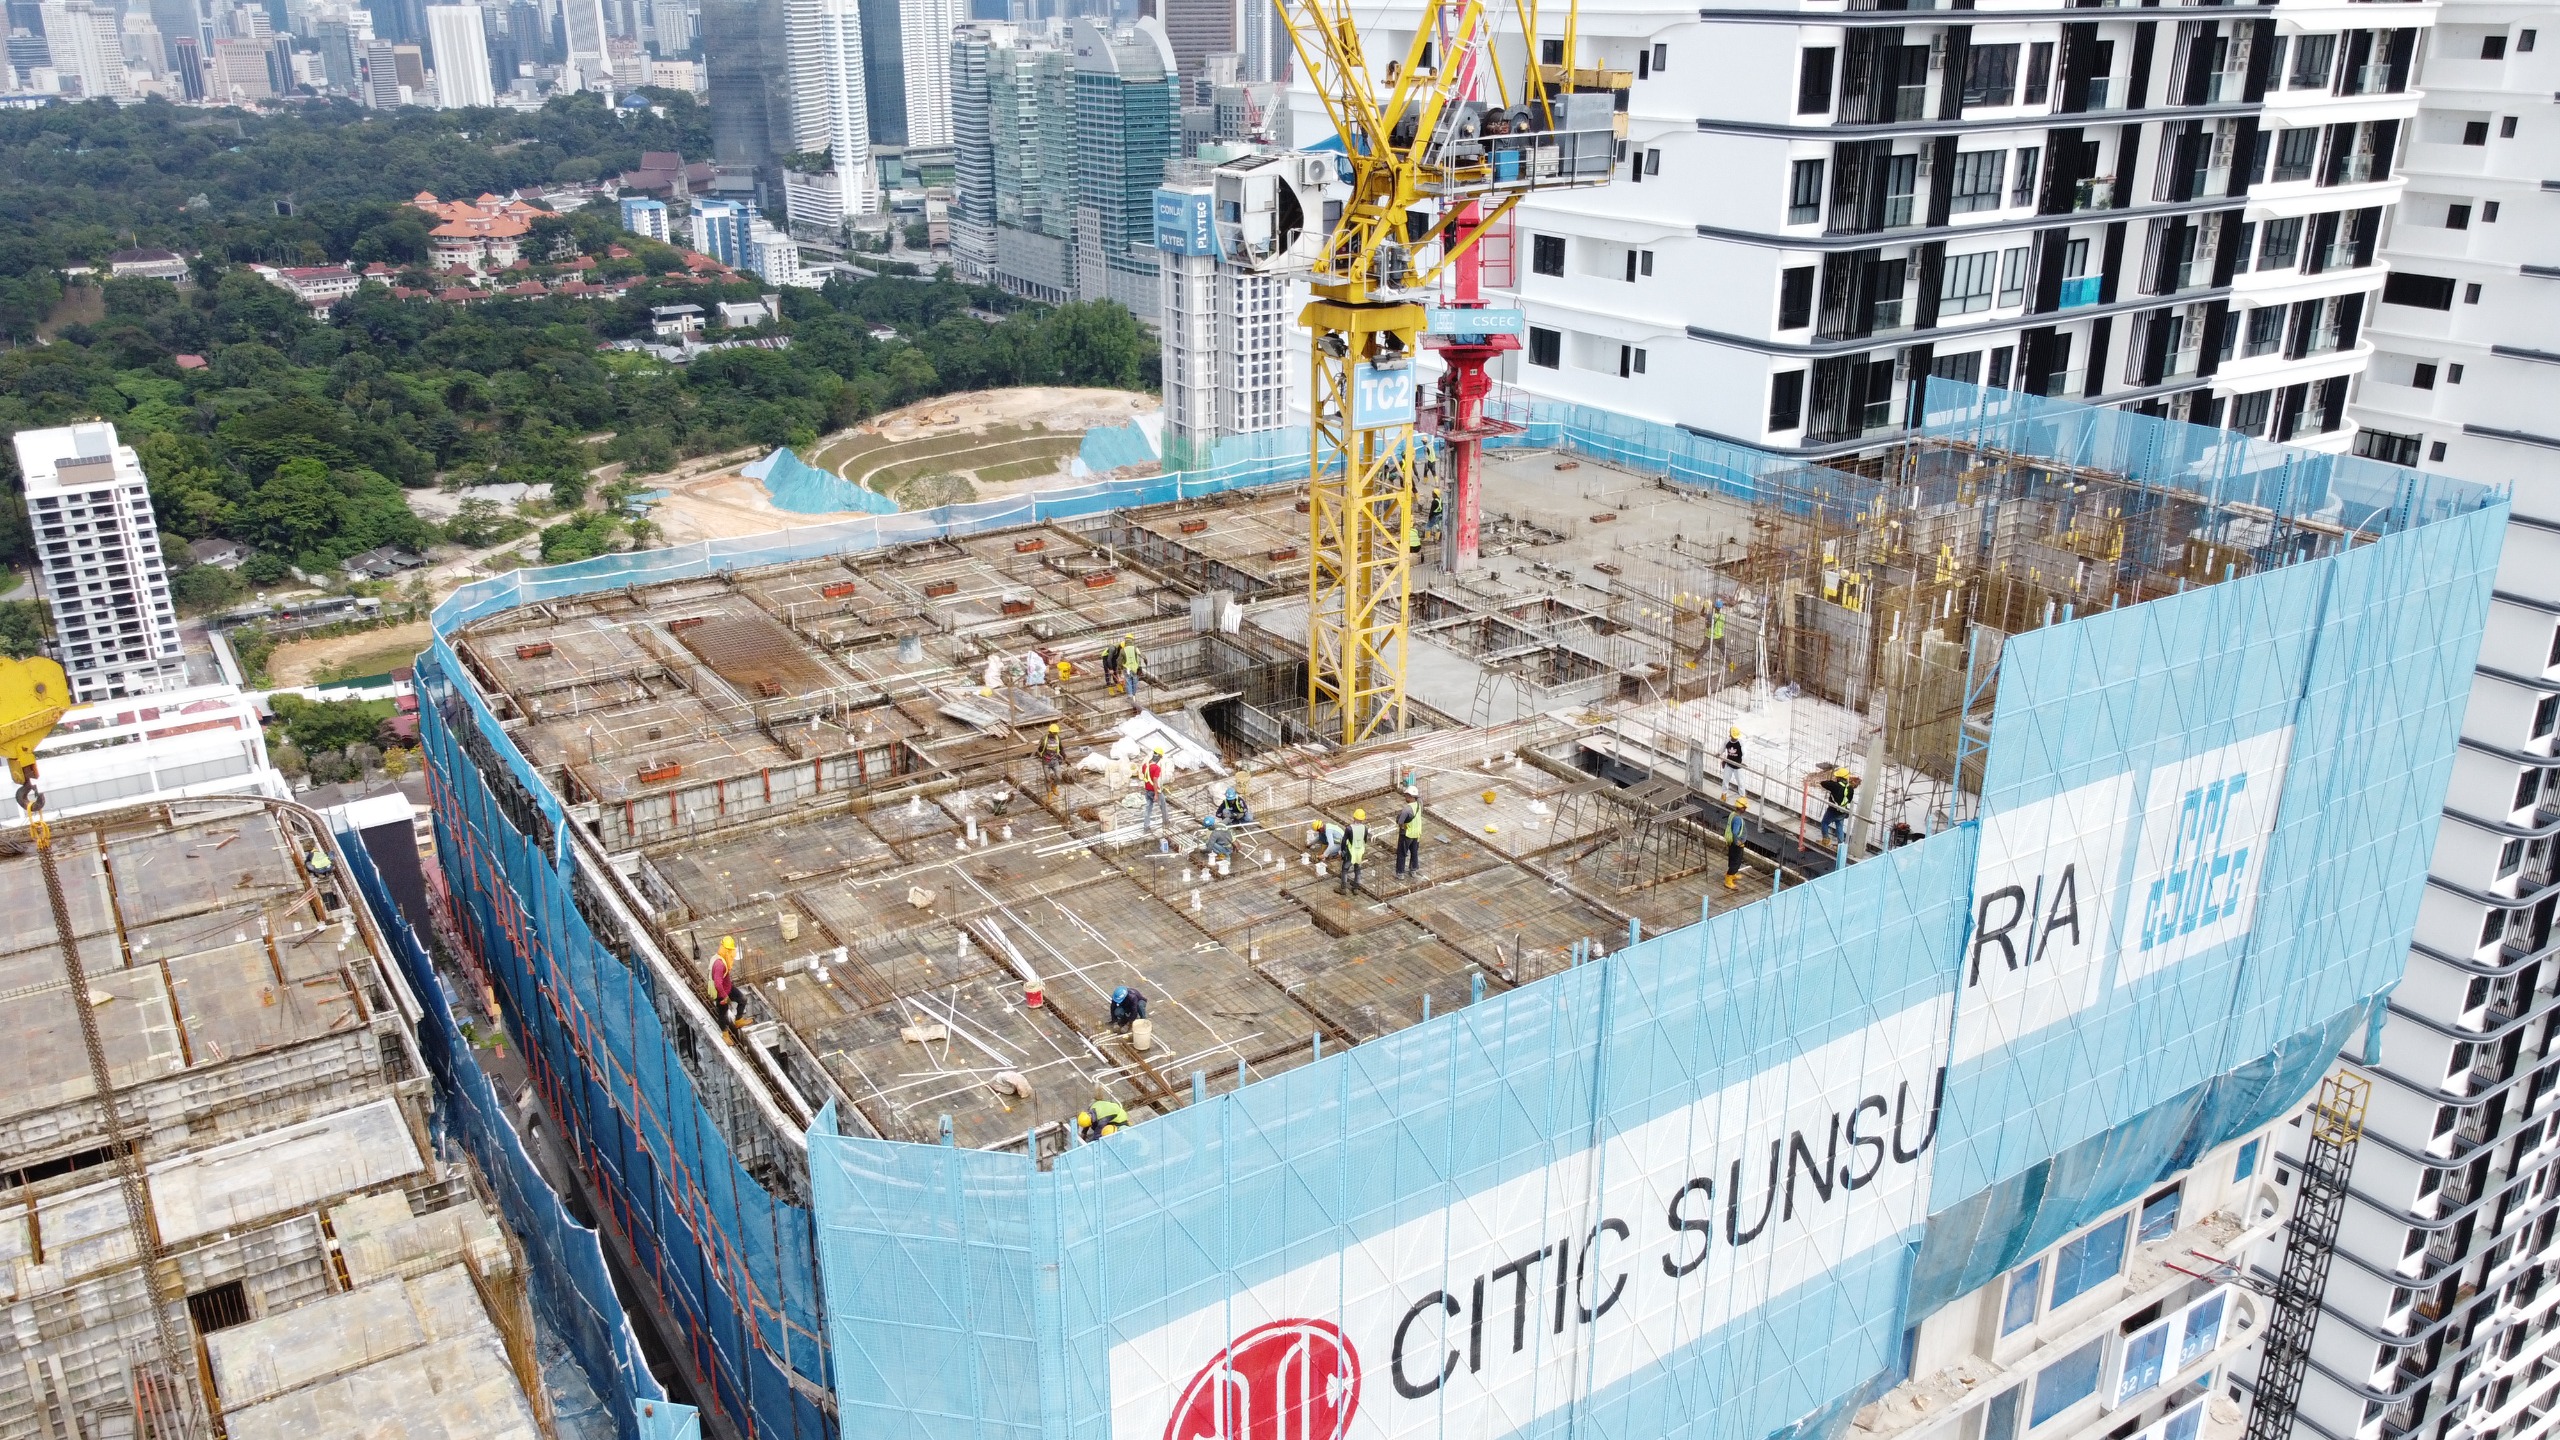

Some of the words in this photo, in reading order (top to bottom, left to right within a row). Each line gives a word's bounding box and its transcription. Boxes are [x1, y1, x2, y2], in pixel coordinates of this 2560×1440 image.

[1160, 204, 1184, 217] CONLAY
[1197, 201, 1207, 249] PLYTEC
[1161, 233, 1185, 247] PLYTEC
[1472, 316, 1516, 327] CSCEC
[1360, 375, 1409, 412] TC2
[1391, 1217, 1630, 1400] CITIC
[1661, 1065, 1948, 1278] SUNSU
[2180, 1342, 2197, 1363] 32
[2201, 1333, 2211, 1350] F
[2120, 1375, 2138, 1397] 32
[2143, 1366, 2155, 1384] F
